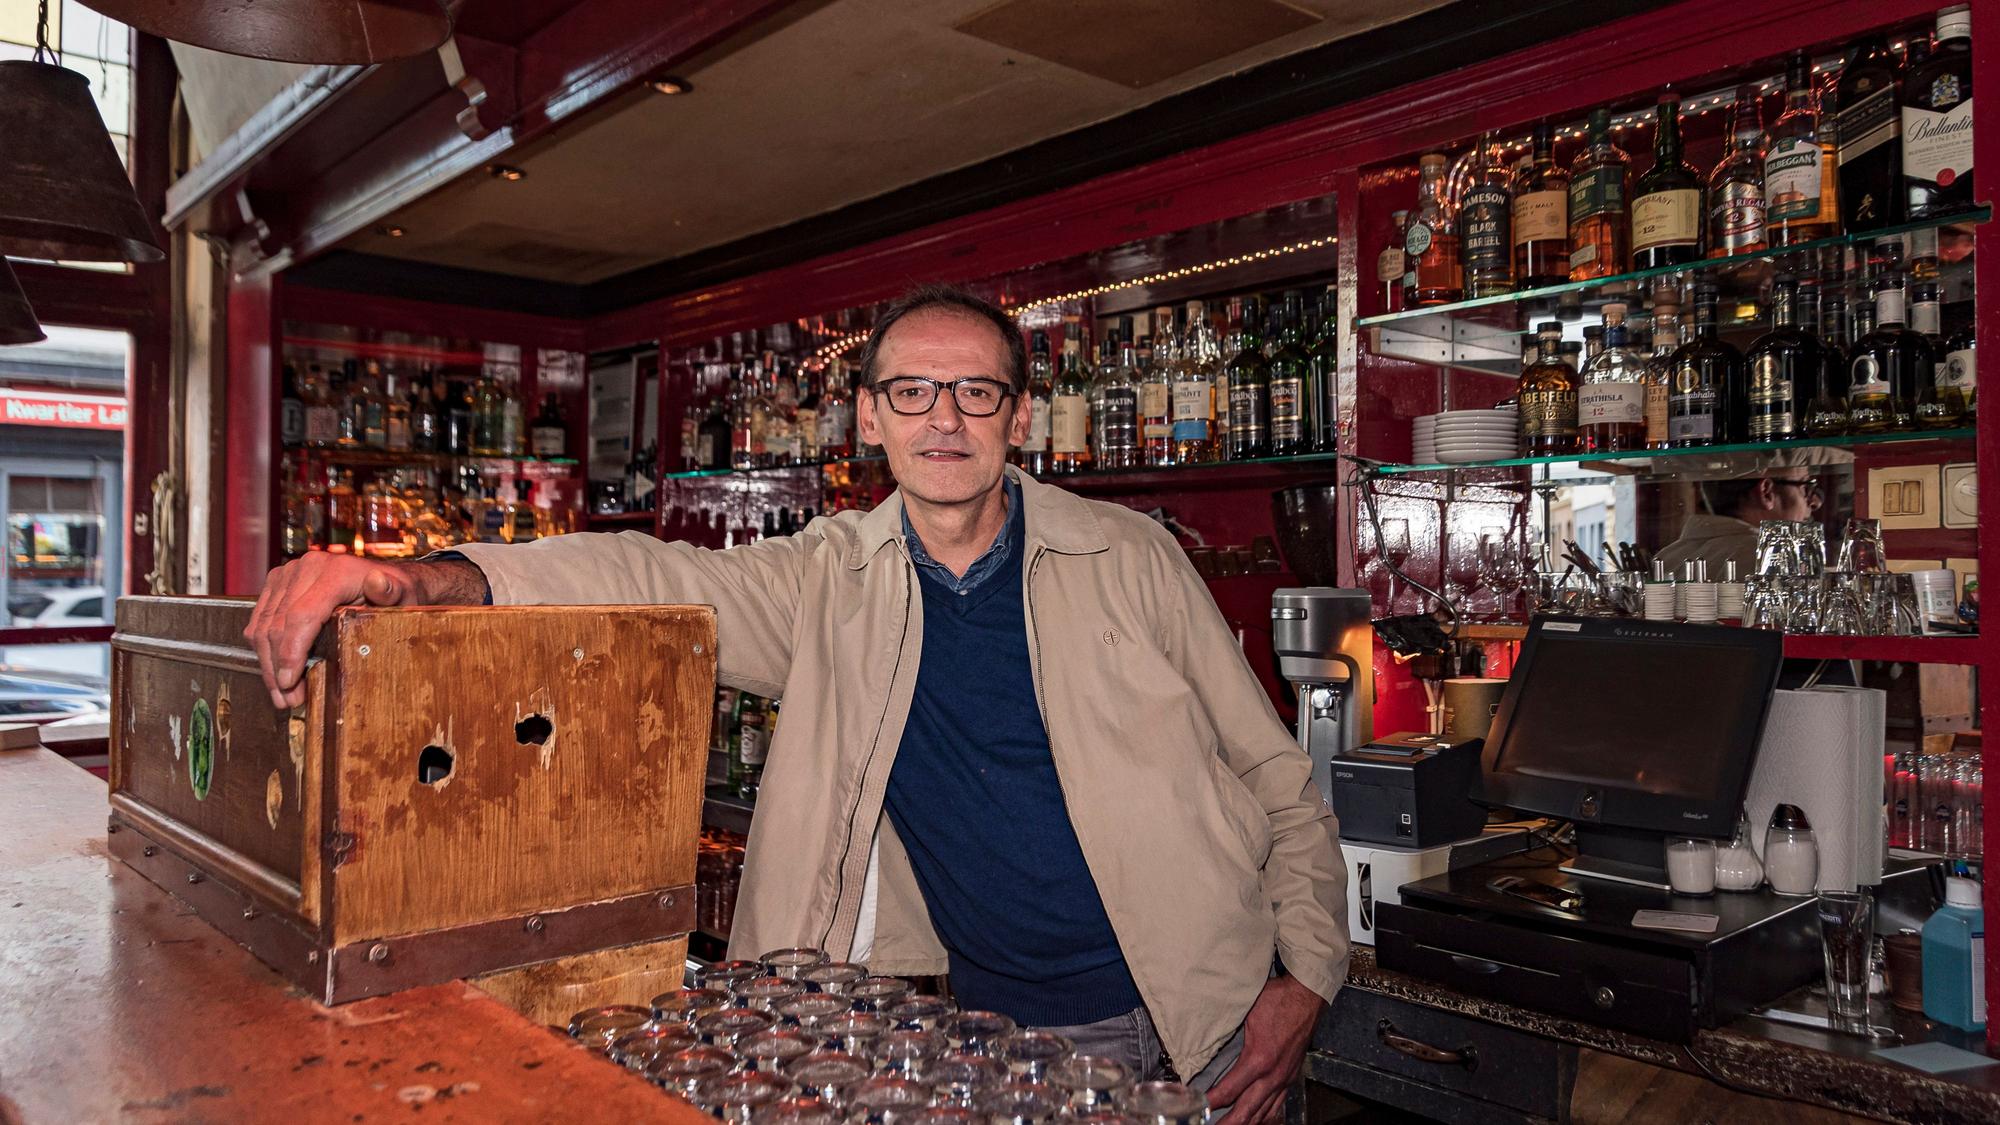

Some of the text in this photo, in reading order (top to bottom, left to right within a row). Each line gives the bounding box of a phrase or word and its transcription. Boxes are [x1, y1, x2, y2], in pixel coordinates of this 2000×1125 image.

[1463, 192, 1506, 211] JAMESON
[1710, 201, 1734, 218] CHIVAS
[1735, 198, 1766, 209] REGAL
[1469, 221, 1497, 235] BLACK
[1642, 224, 1656, 235] 12
[1468, 236, 1501, 249] BARREL
[1108, 397, 1134, 406] MATIN
[6, 398, 94, 423] Kwartier
[1544, 411, 1557, 420] 12
[1592, 407, 1605, 417] 12
